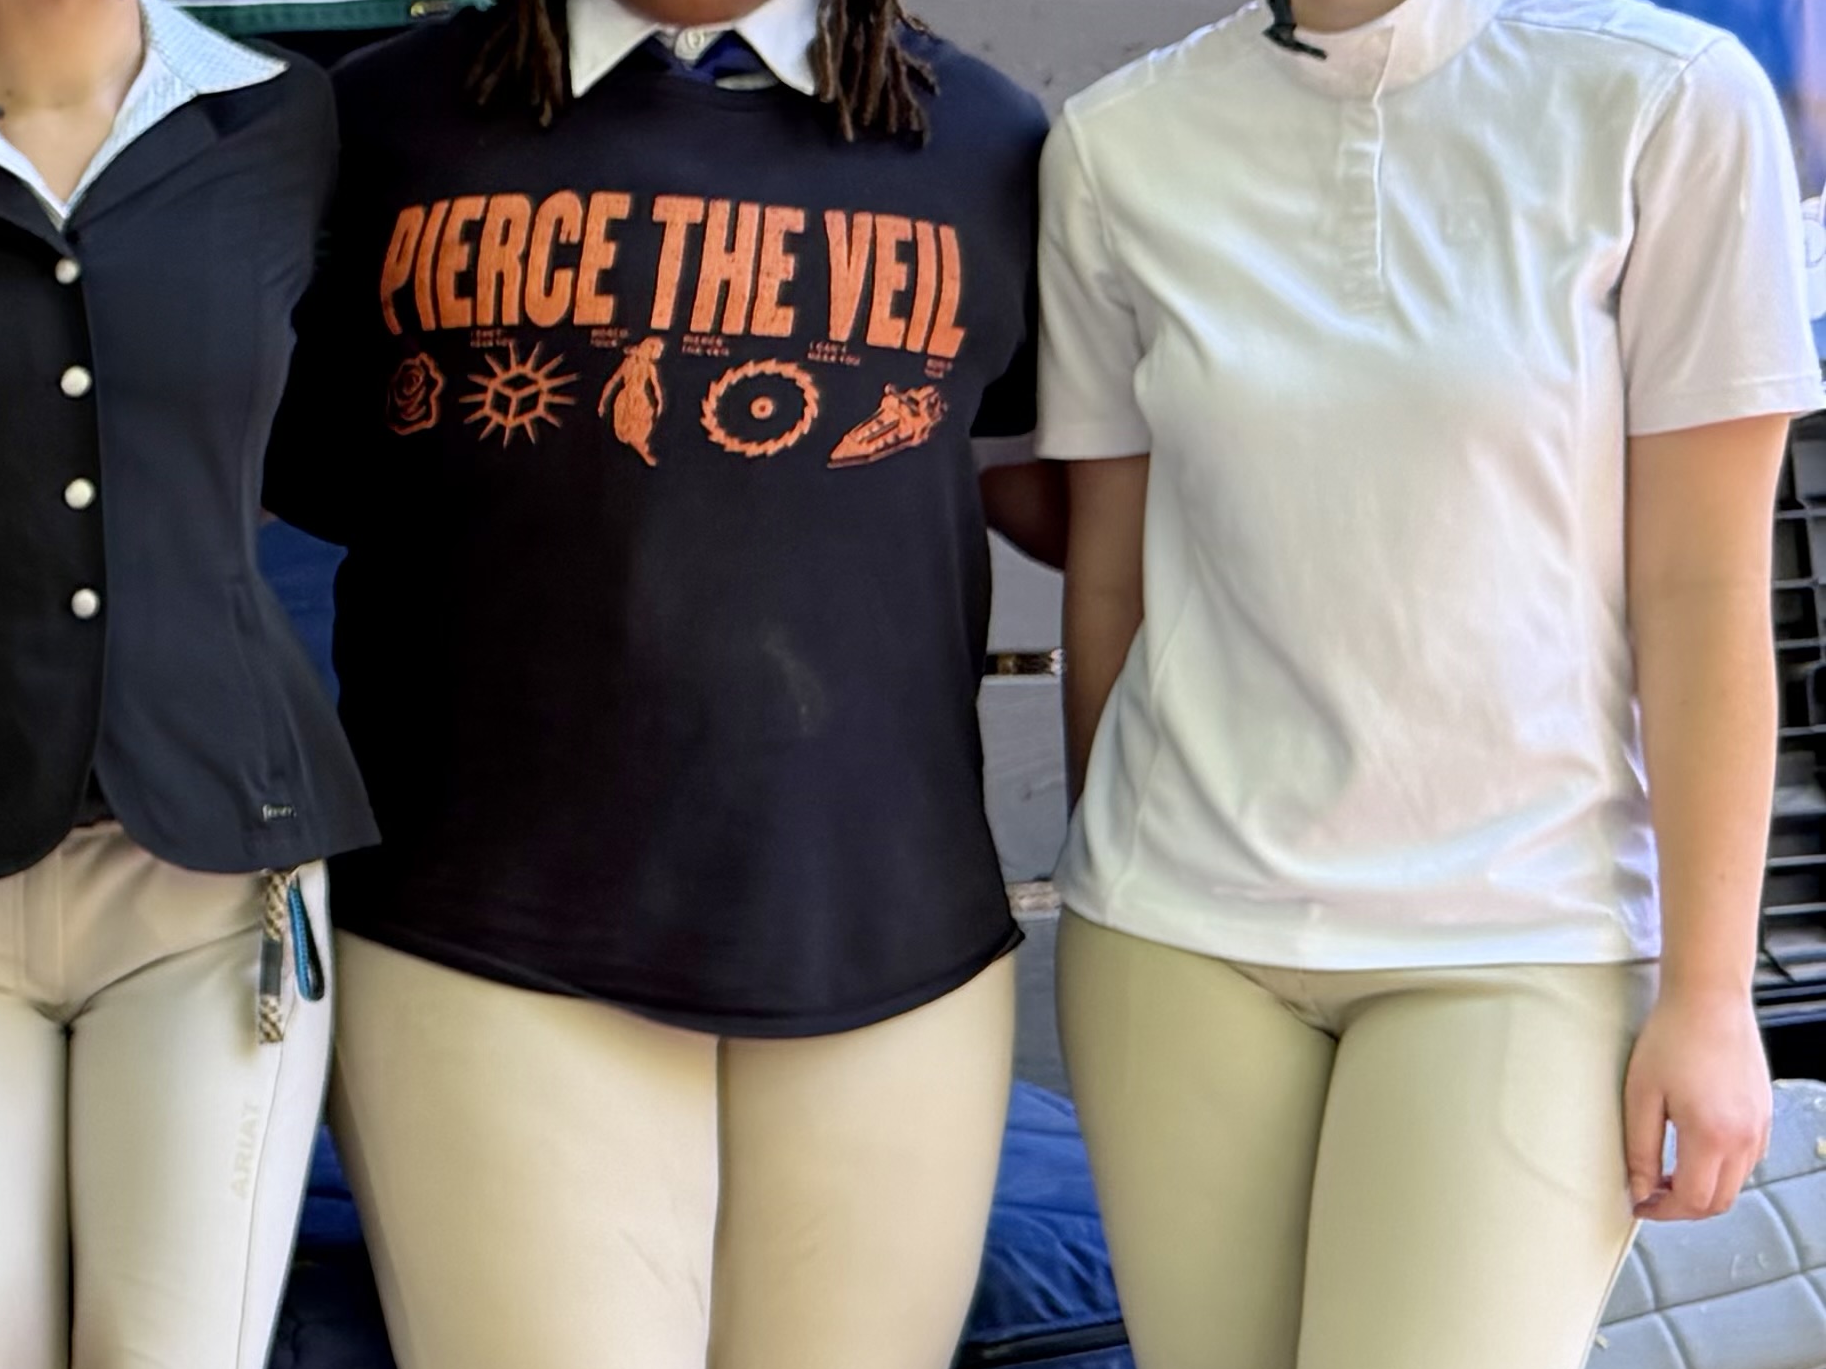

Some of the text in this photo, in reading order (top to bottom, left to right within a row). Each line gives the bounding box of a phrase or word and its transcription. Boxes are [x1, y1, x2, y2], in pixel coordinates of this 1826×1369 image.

[380, 190, 966, 358] PIERCE THE VEIL
